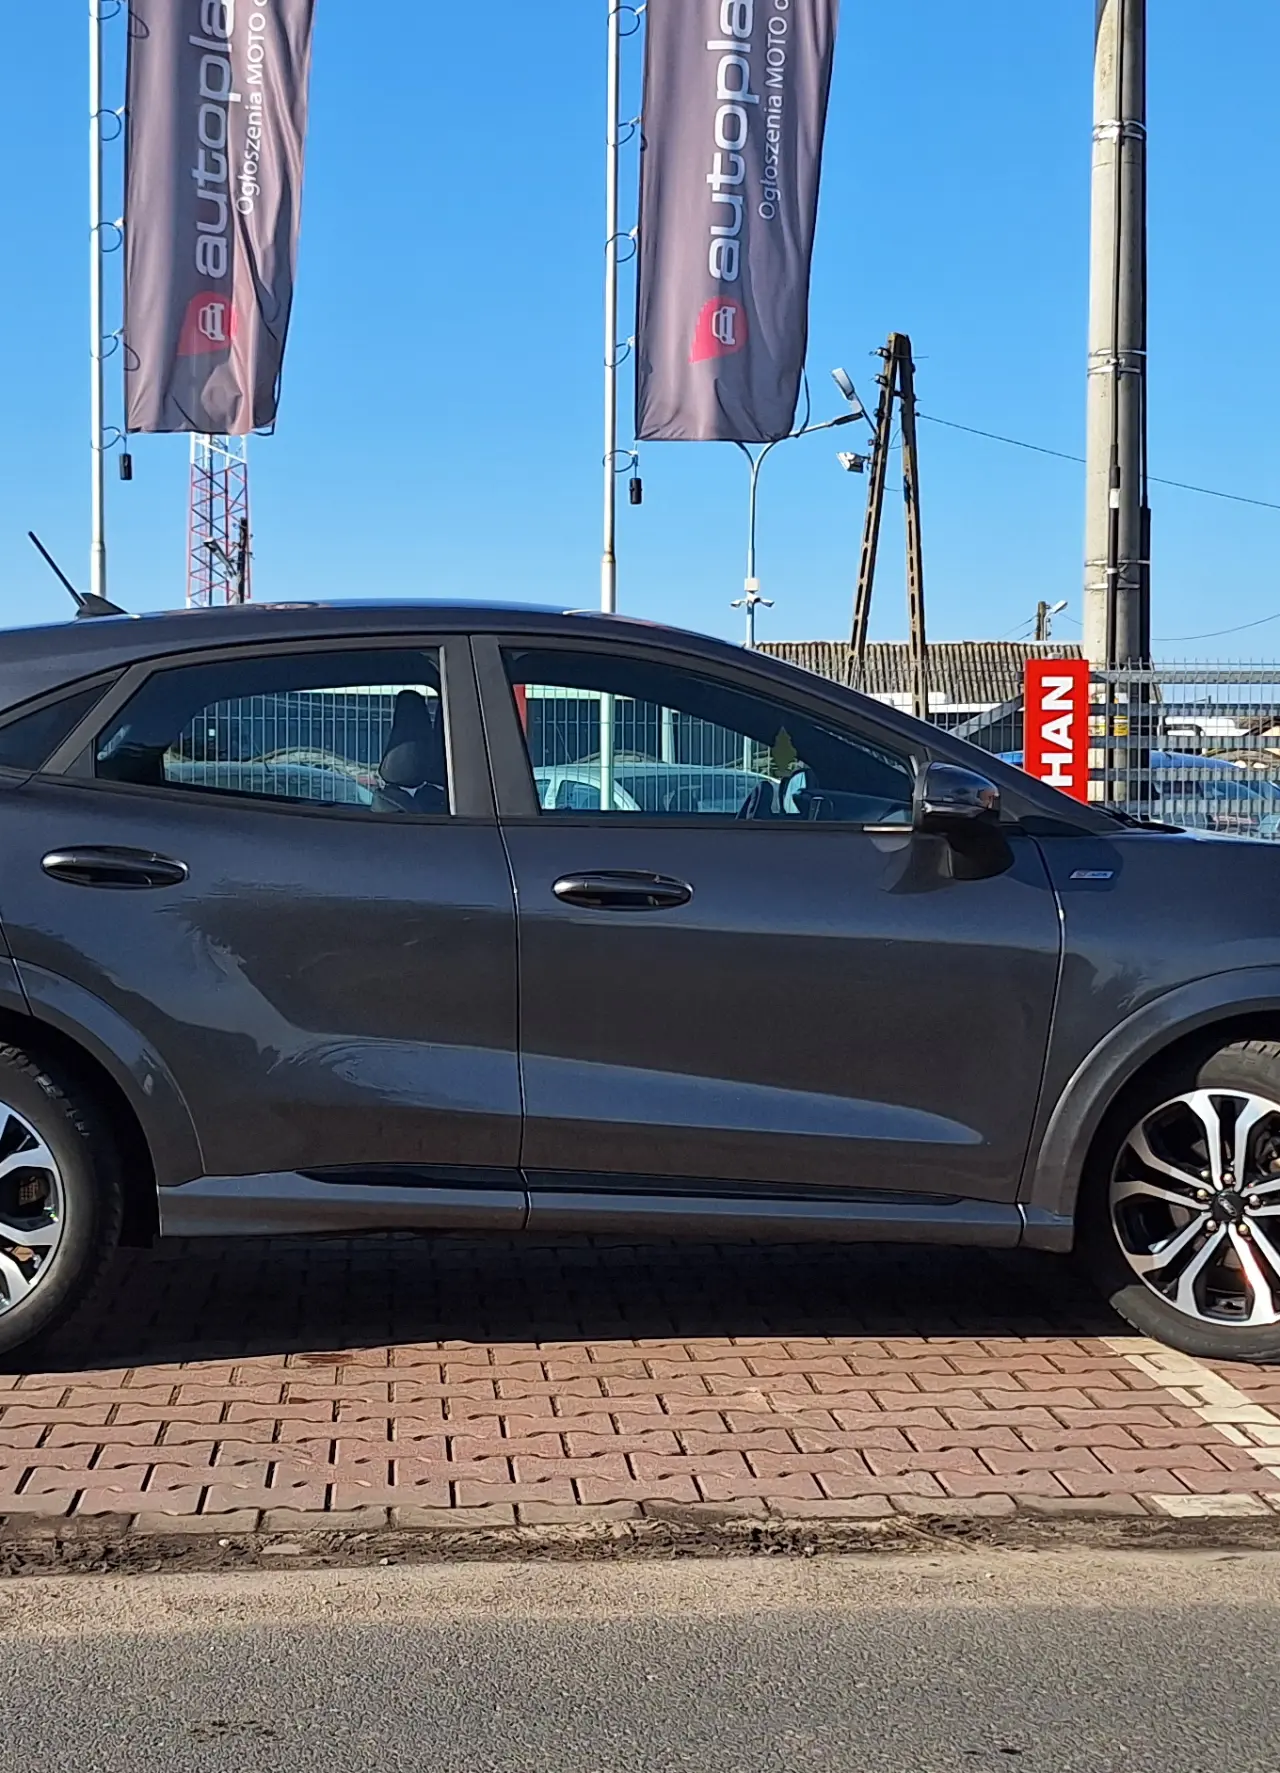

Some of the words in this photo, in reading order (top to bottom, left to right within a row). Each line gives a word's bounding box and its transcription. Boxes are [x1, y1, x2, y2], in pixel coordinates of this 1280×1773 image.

[246, 12, 266, 86] MOTO
[764, 16, 788, 88] MOTO
[236, 93, 263, 216] Ogłoszenia
[758, 95, 783, 221] Ogłoszenia
[1040, 676, 1073, 786] HAN
